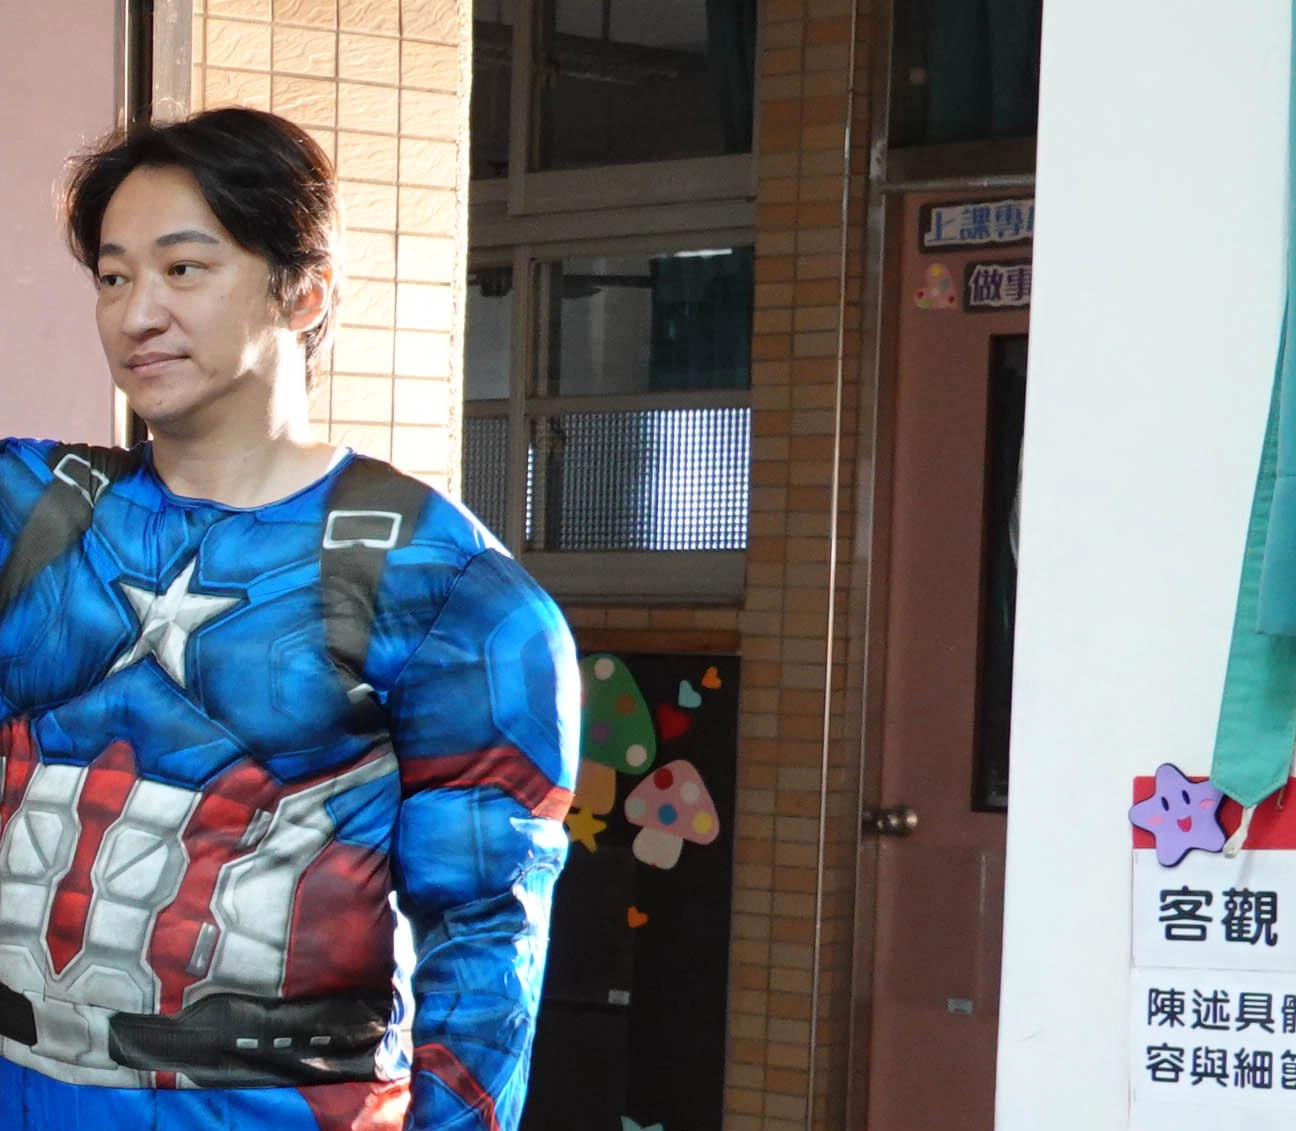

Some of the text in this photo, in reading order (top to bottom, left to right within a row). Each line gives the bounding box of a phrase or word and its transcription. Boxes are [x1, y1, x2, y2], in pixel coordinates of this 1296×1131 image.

[928, 200, 1035, 243] 上課專
[1158, 886, 1278, 947] 客觀
